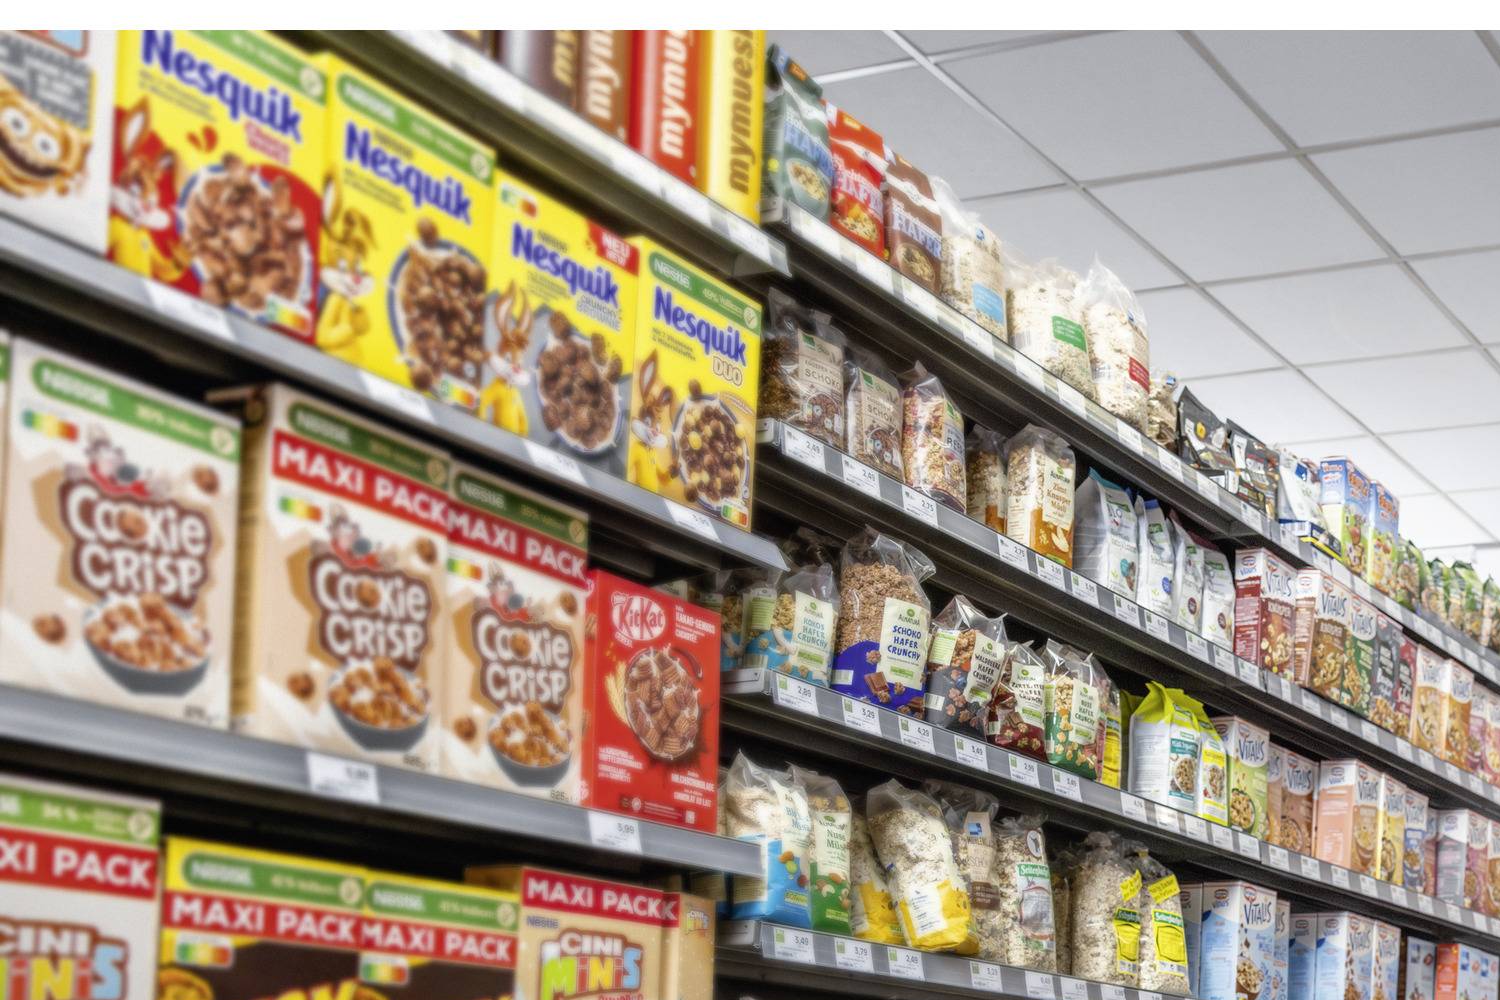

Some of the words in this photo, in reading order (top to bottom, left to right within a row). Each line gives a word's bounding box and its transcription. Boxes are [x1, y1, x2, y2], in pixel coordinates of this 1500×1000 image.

[141, 30, 303, 145] Nesquik
[344, 120, 473, 226] Nesquik
[511, 222, 620, 311] Nesquik
[652, 285, 747, 367] Nesquik
[711, 355, 744, 388] DUO
[278, 441, 363, 496] MAXI
[374, 474, 449, 529] PACK
[448, 506, 517, 554] MAXI
[525, 537, 586, 580] PACK
[802, 625, 826, 639] HAFER
[803, 616, 825, 630] KOKOS
[892, 624, 922, 639] SCHOKO
[797, 633, 828, 649] CRUNCHY
[887, 645, 921, 661] CRUNCHY
[893, 636, 919, 649] HAFER
[972, 670, 995, 685] CRUNCHY
[976, 663, 995, 677] HAFER
[826, 839, 846, 848] Müsl
[0, 840, 37, 874] XI
[53, 847, 152, 889] PACK
[527, 876, 593, 908] MAXI
[602, 888, 662, 919] PACK
[171, 895, 265, 932] MAXI
[277, 909, 357, 944] PACK
[362, 922, 434, 951] MAXI
[445, 933, 512, 962] PACK
[560, 932, 624, 955] CINI
